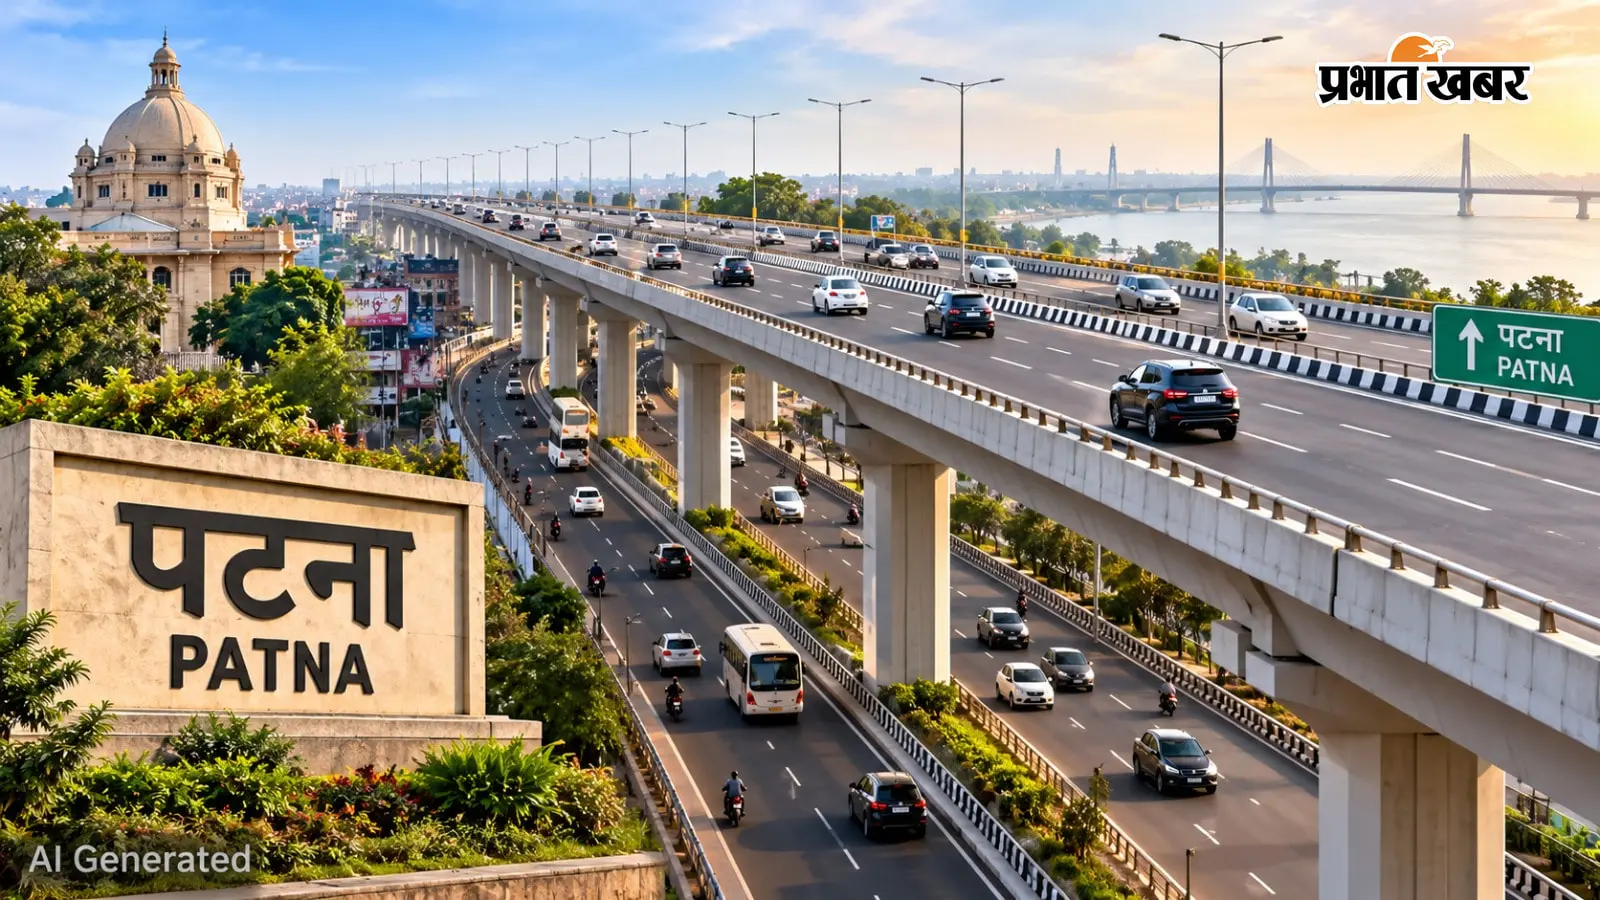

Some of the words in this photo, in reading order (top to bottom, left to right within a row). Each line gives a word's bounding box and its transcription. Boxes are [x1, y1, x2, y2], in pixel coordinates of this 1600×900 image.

[1497, 324, 1564, 353] पटना
[1497, 356, 1575, 387] PATNA
[117, 502, 416, 629] पटना
[169, 634, 375, 695] PATNA
